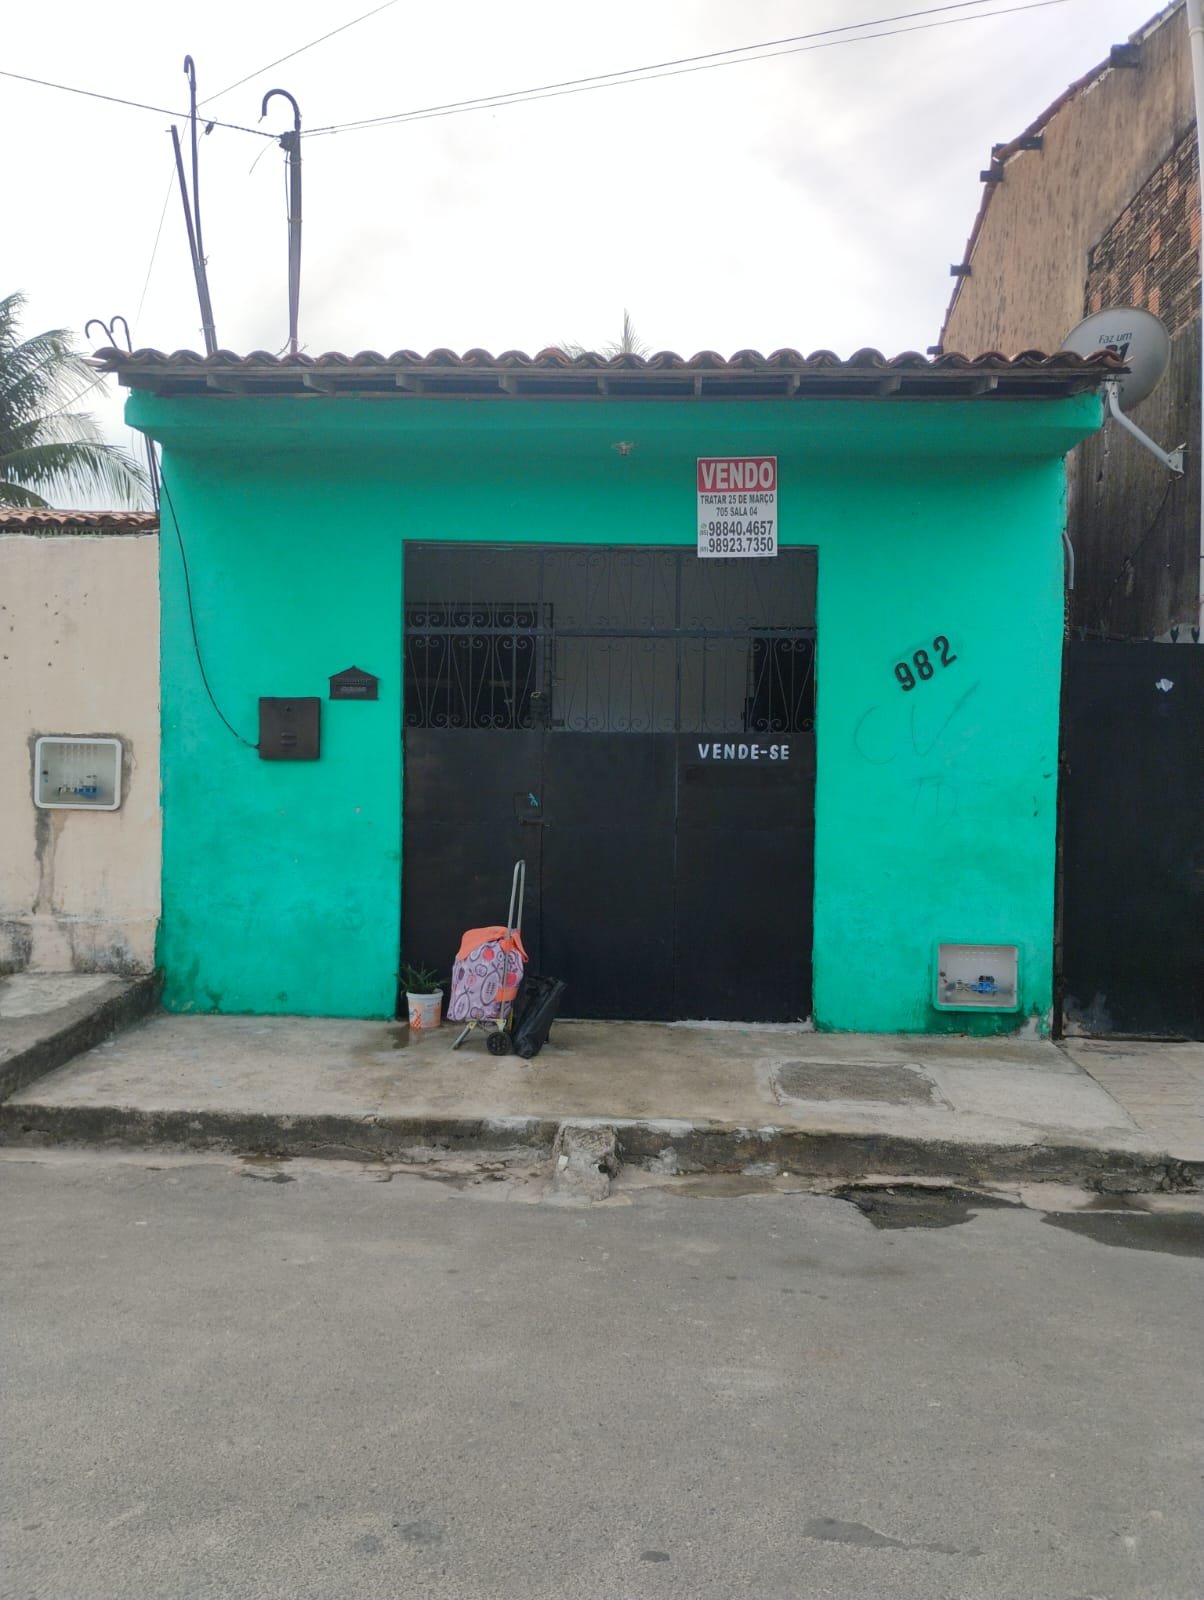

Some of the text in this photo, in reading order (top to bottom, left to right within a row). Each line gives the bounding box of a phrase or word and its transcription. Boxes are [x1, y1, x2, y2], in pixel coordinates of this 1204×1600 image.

[1098, 332, 1133, 344] Faz um
[701, 461, 774, 490] VENDO
[701, 493, 774, 507] TRATAR 25 DE MARÇO
[716, 507, 758, 517] 705 SALA 04
[708, 520, 774, 537] 98840.4657
[708, 537, 774, 553] 98923.7350
[894, 635, 958, 692] 982
[698, 743, 790, 760] VENDE-SE
